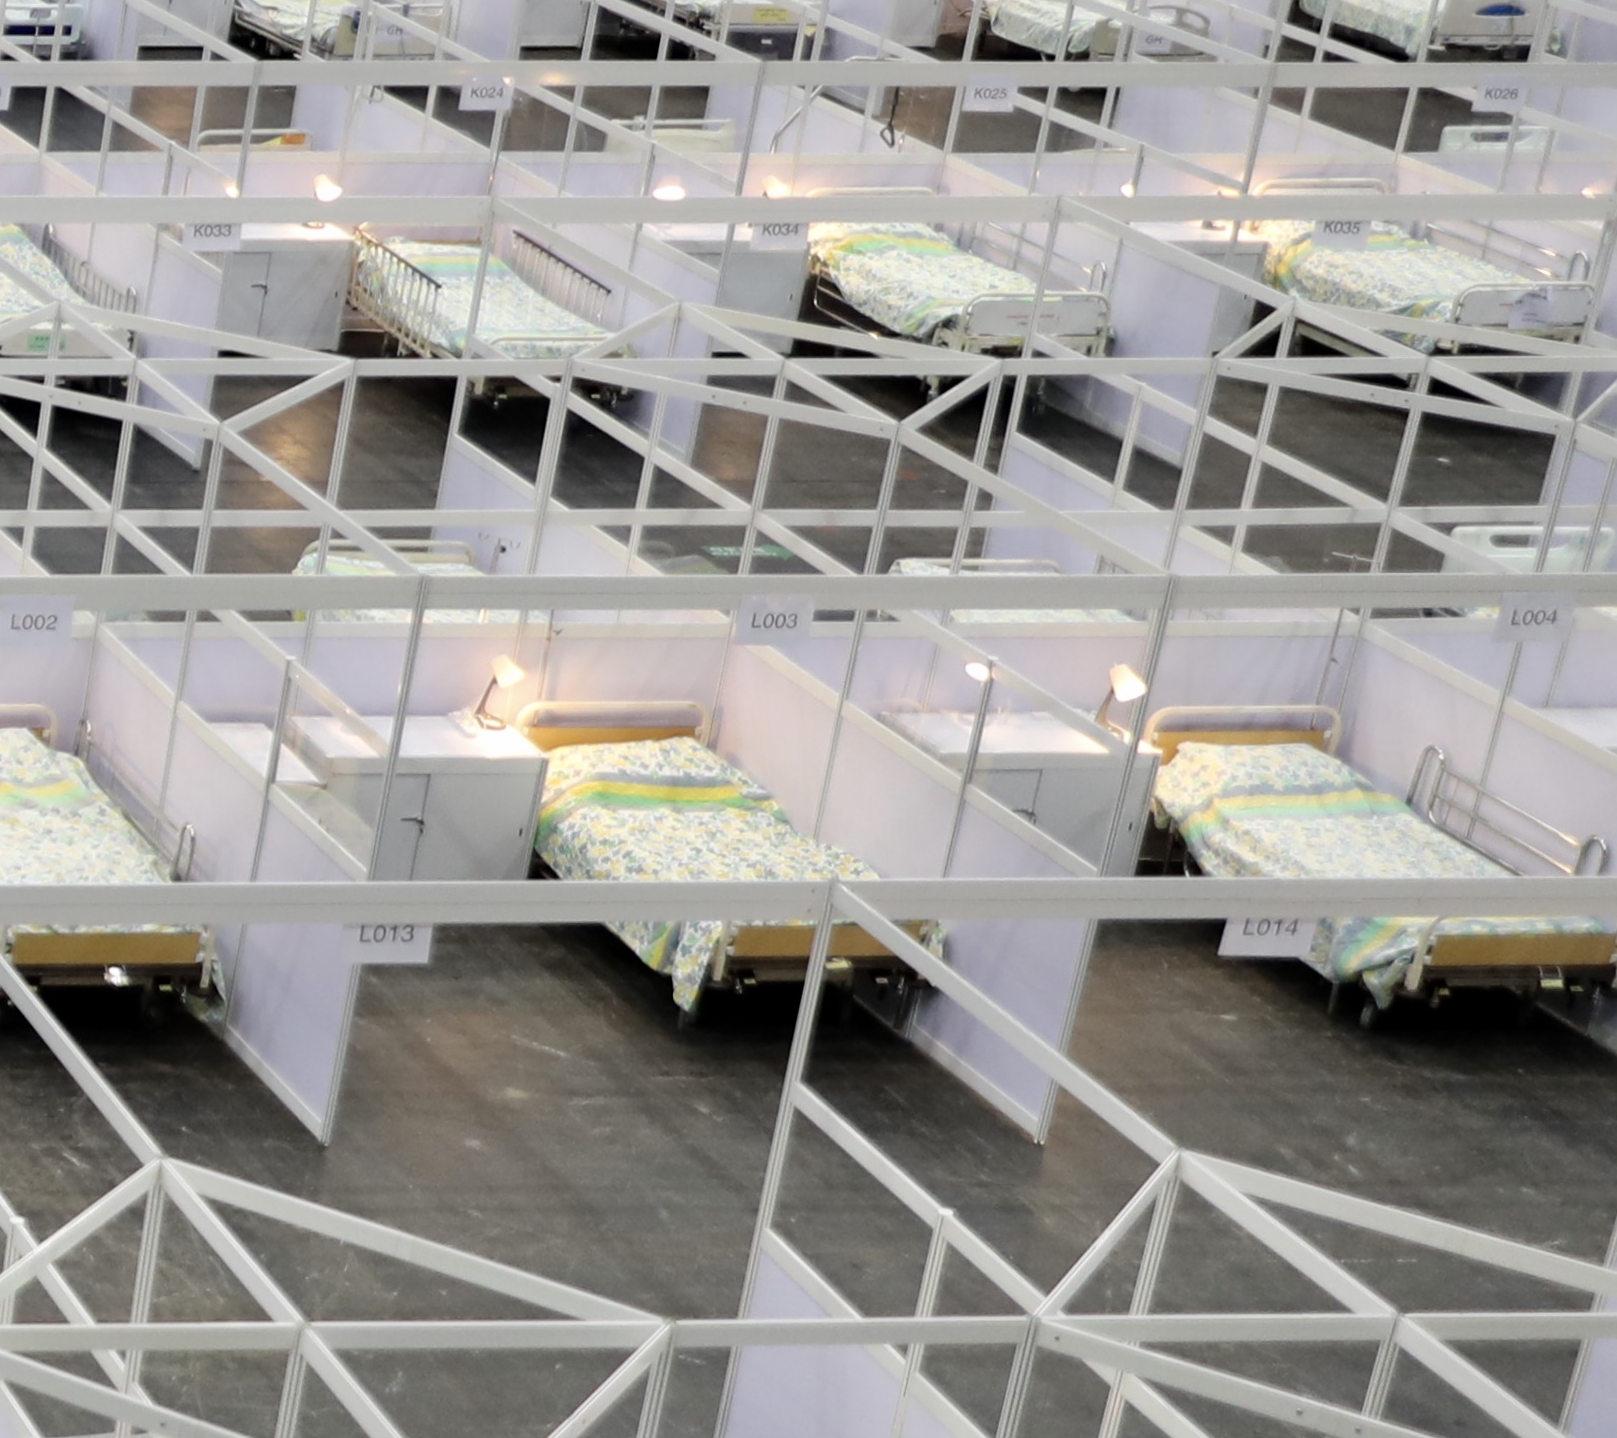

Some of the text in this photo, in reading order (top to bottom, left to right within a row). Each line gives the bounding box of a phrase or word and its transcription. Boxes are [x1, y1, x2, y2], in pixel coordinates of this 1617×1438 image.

[470, 88, 505, 99] K024
[973, 88, 1007, 99] K025
[1484, 88, 1518, 99] K026
[193, 223, 231, 237] K033
[762, 222, 799, 236] K034
[1323, 221, 1361, 234] K035
[10, 614, 58, 631] L002
[751, 613, 798, 629] L003
[1510, 609, 1558, 625] L004
[359, 924, 415, 943] L013
[1242, 918, 1299, 936] L014
